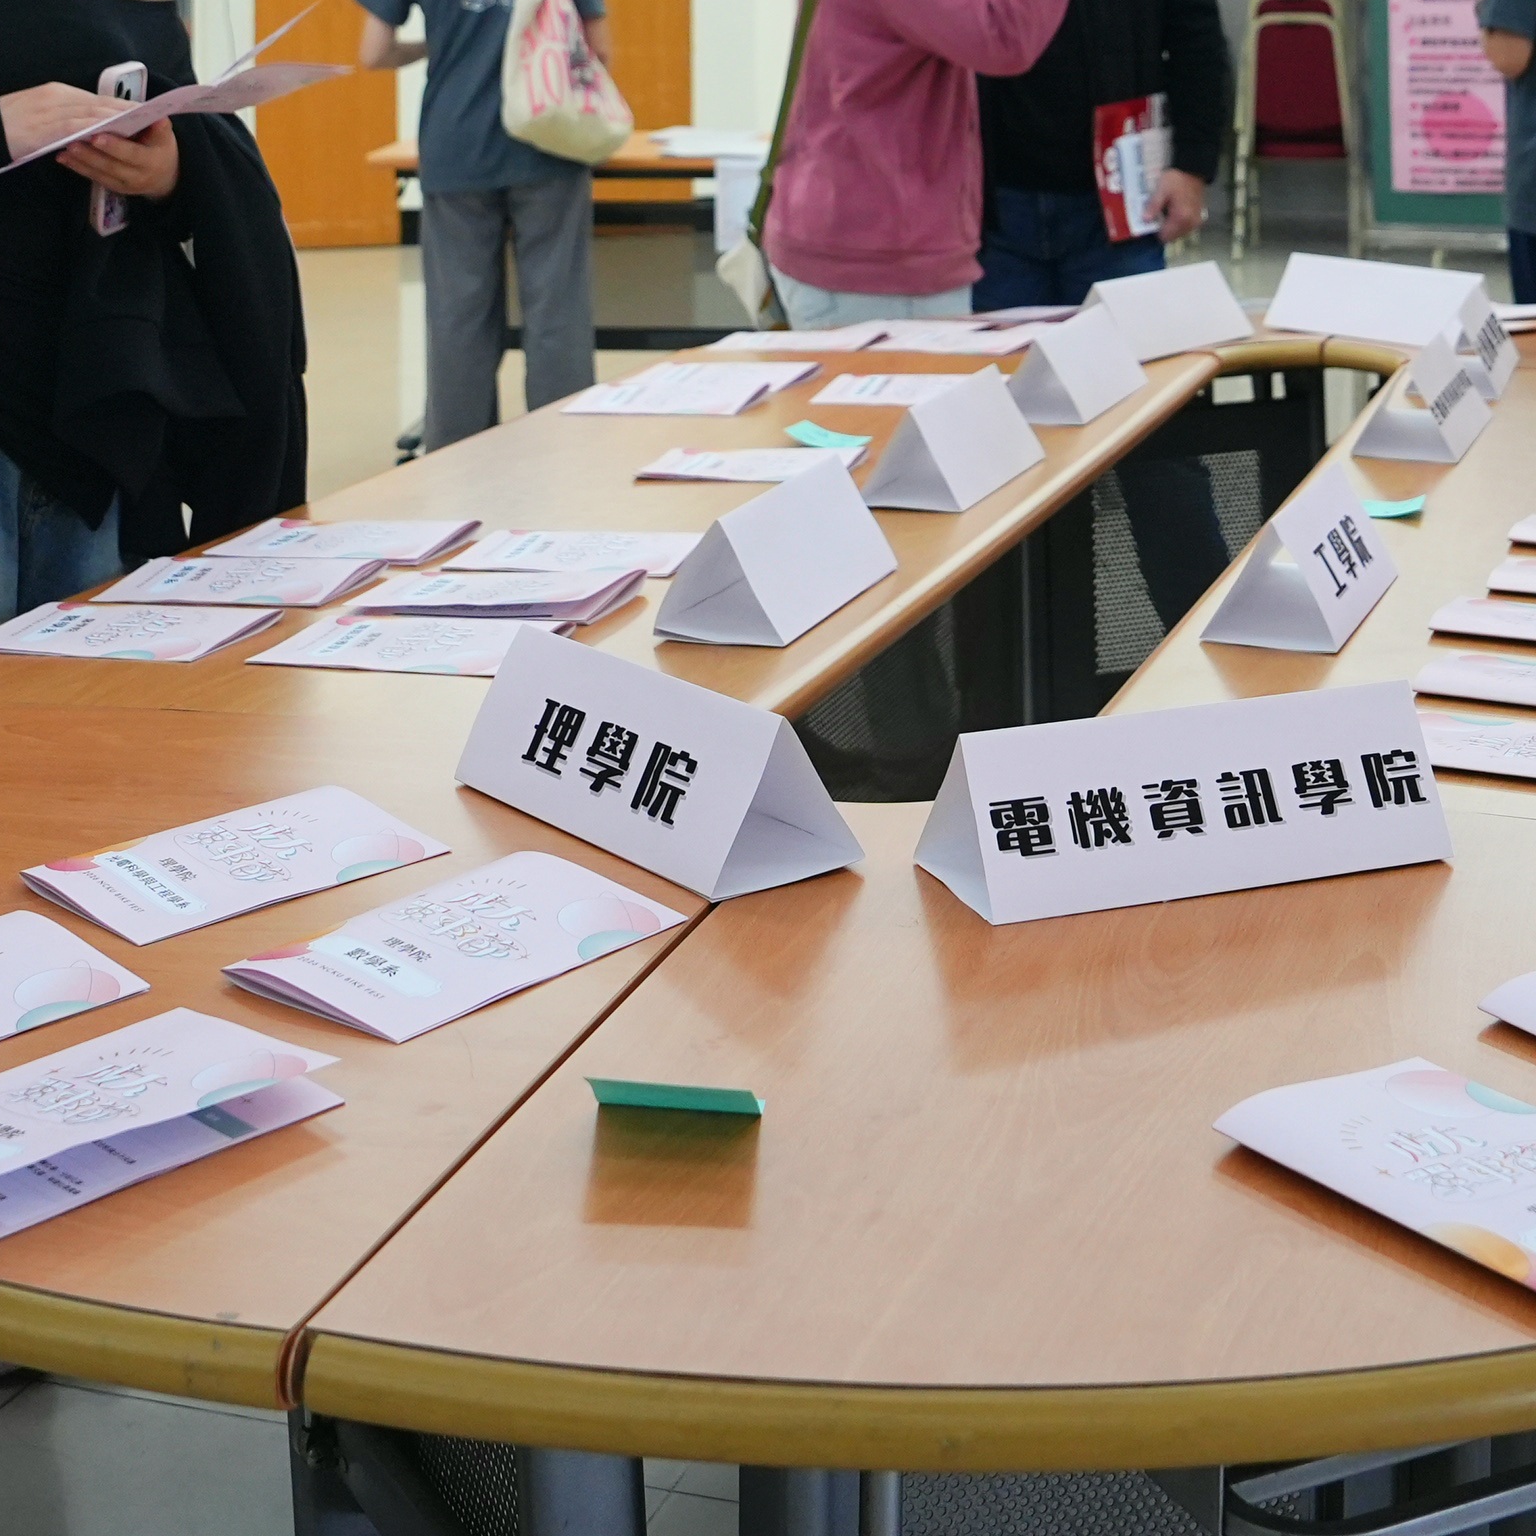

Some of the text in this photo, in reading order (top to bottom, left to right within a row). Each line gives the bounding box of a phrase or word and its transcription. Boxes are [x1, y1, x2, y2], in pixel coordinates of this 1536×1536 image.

[1312, 514, 1374, 598] 工學院
[521, 697, 699, 827] 理學院
[988, 748, 1432, 859] 電機資訊學院
[105, 854, 193, 910] 光電科學與工程學系
[158, 856, 197, 882] 理學院
[343, 946, 401, 978] 數學系
[382, 936, 432, 964] 理學院
